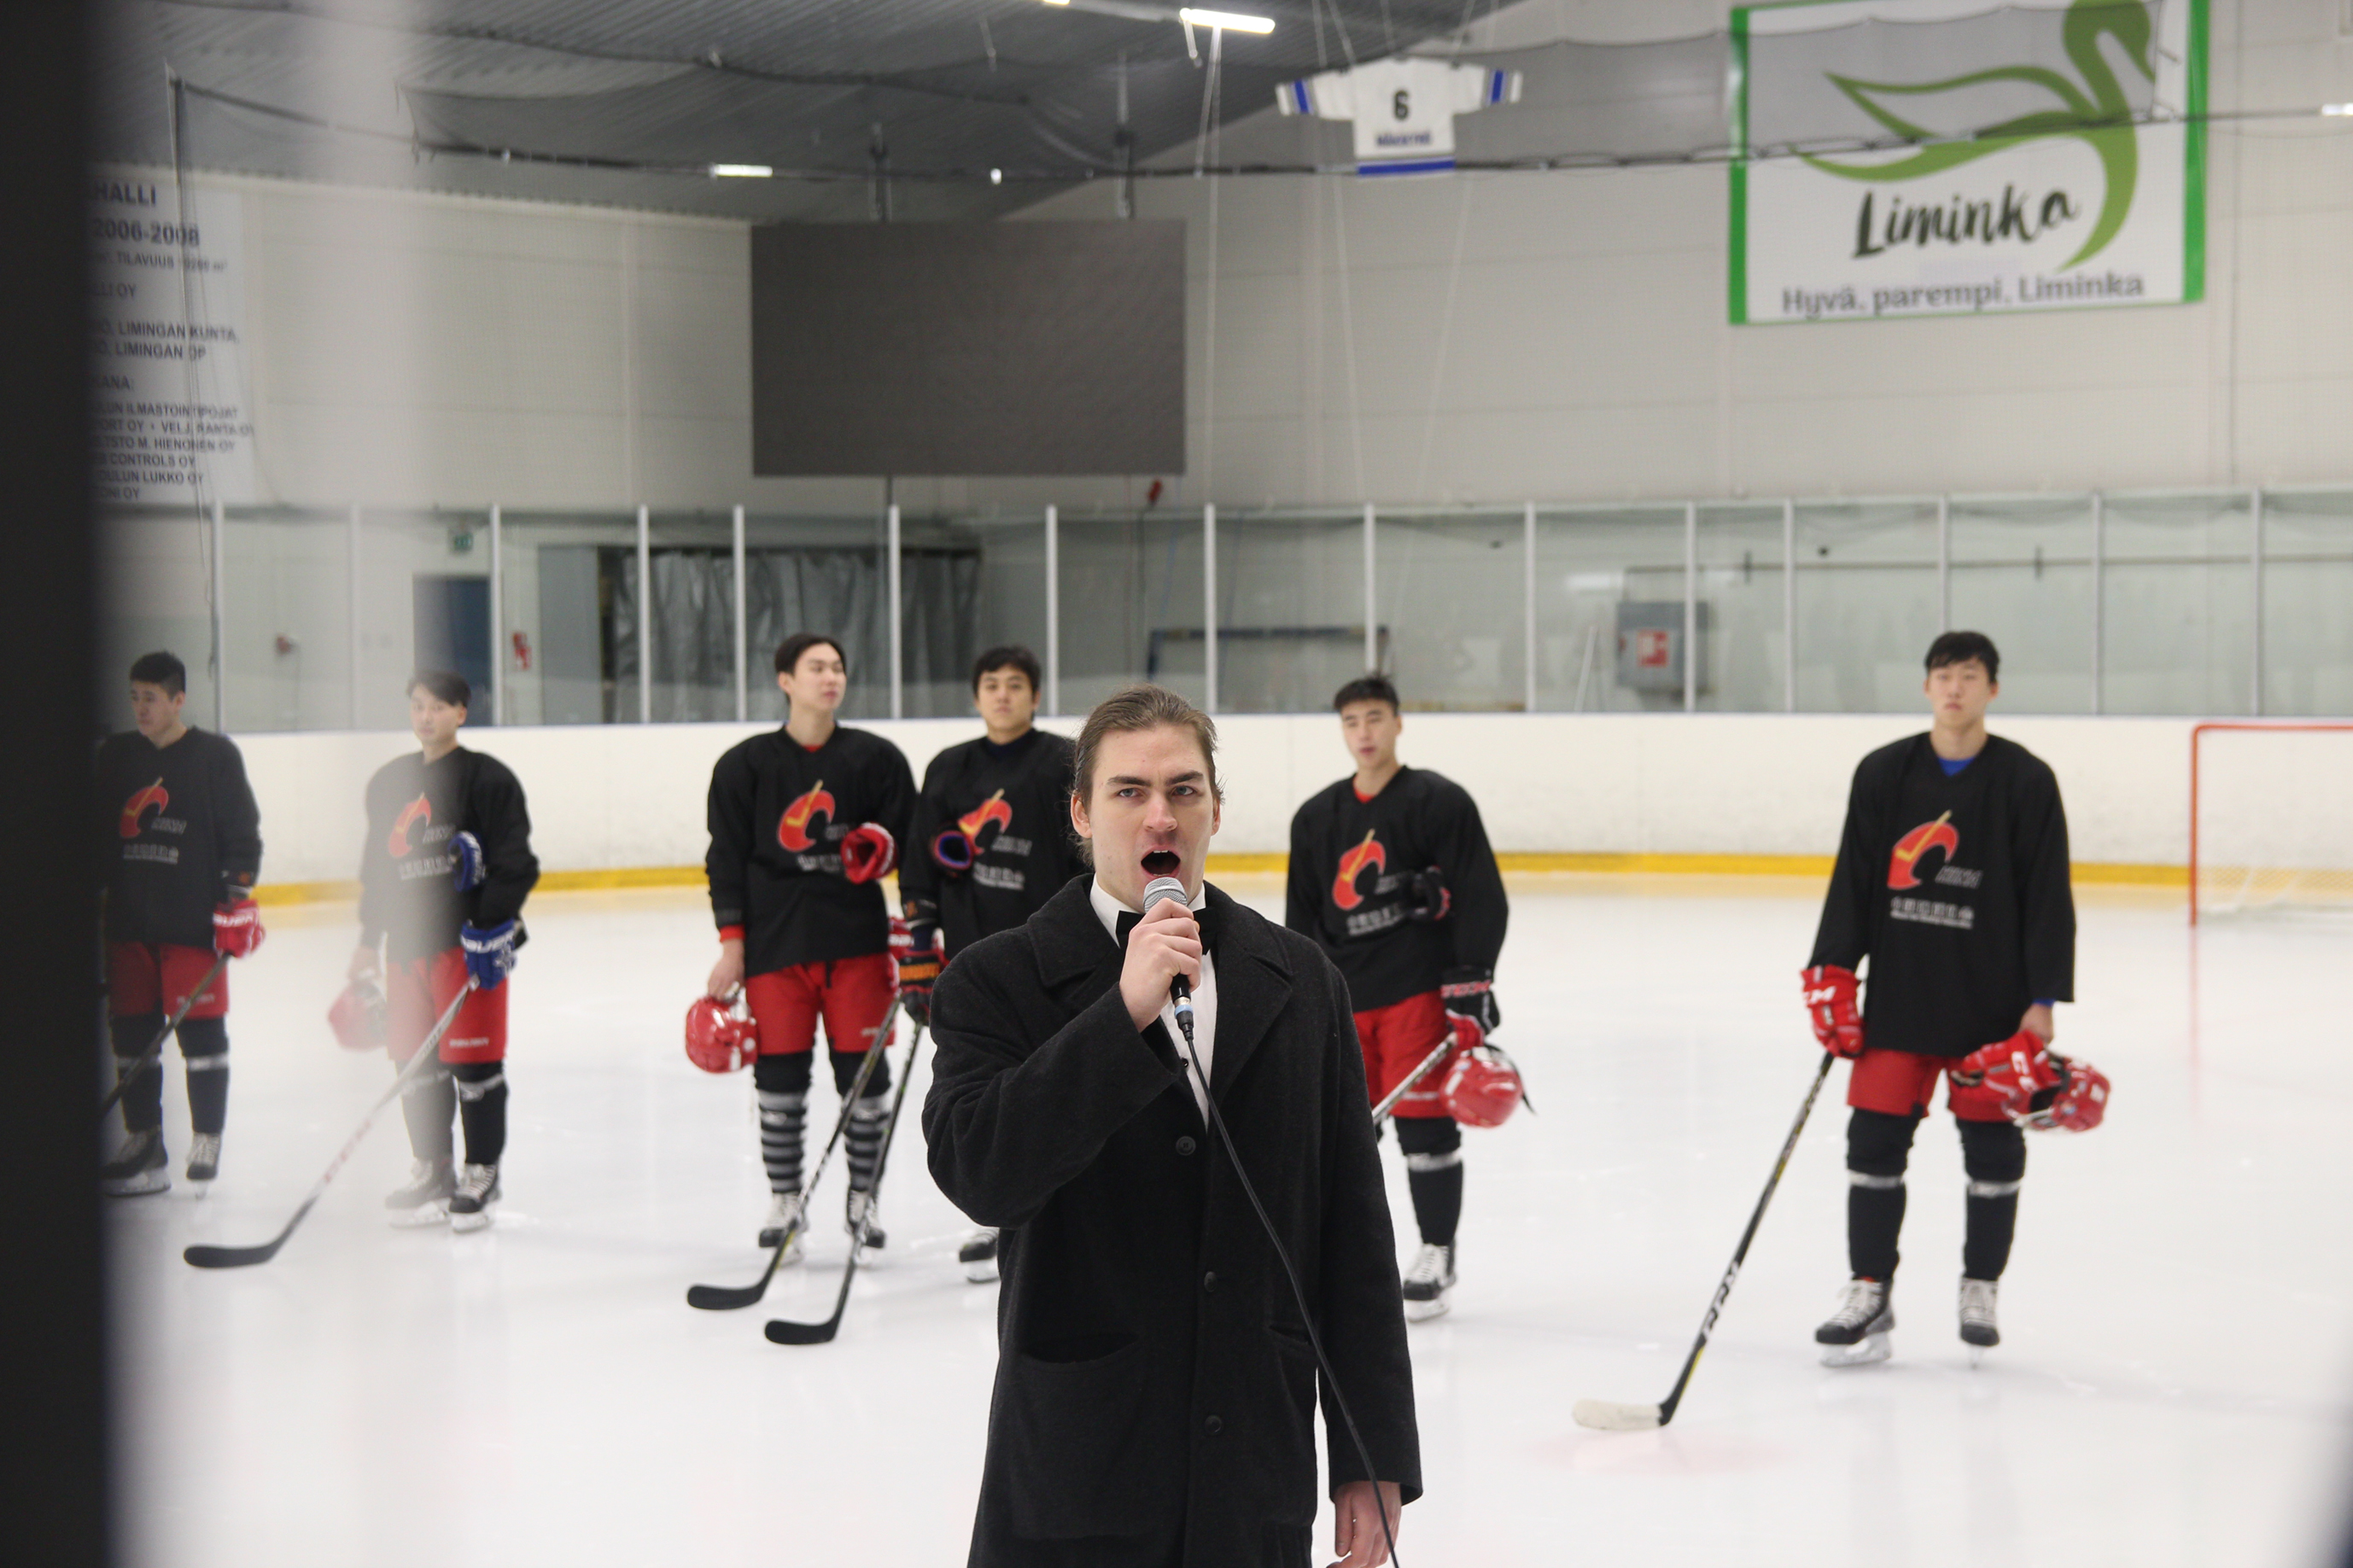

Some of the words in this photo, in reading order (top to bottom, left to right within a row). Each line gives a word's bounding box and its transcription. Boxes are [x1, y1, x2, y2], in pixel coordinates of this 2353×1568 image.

[1393, 90, 1411, 120] 6
[1852, 184, 2080, 259] Liminka
[2018, 268, 2146, 302] Liminka
[115, 341, 184, 360] LIMINGAN
[110, 452, 176, 468] CONTROLS
[143, 471, 184, 486] LUKKO
